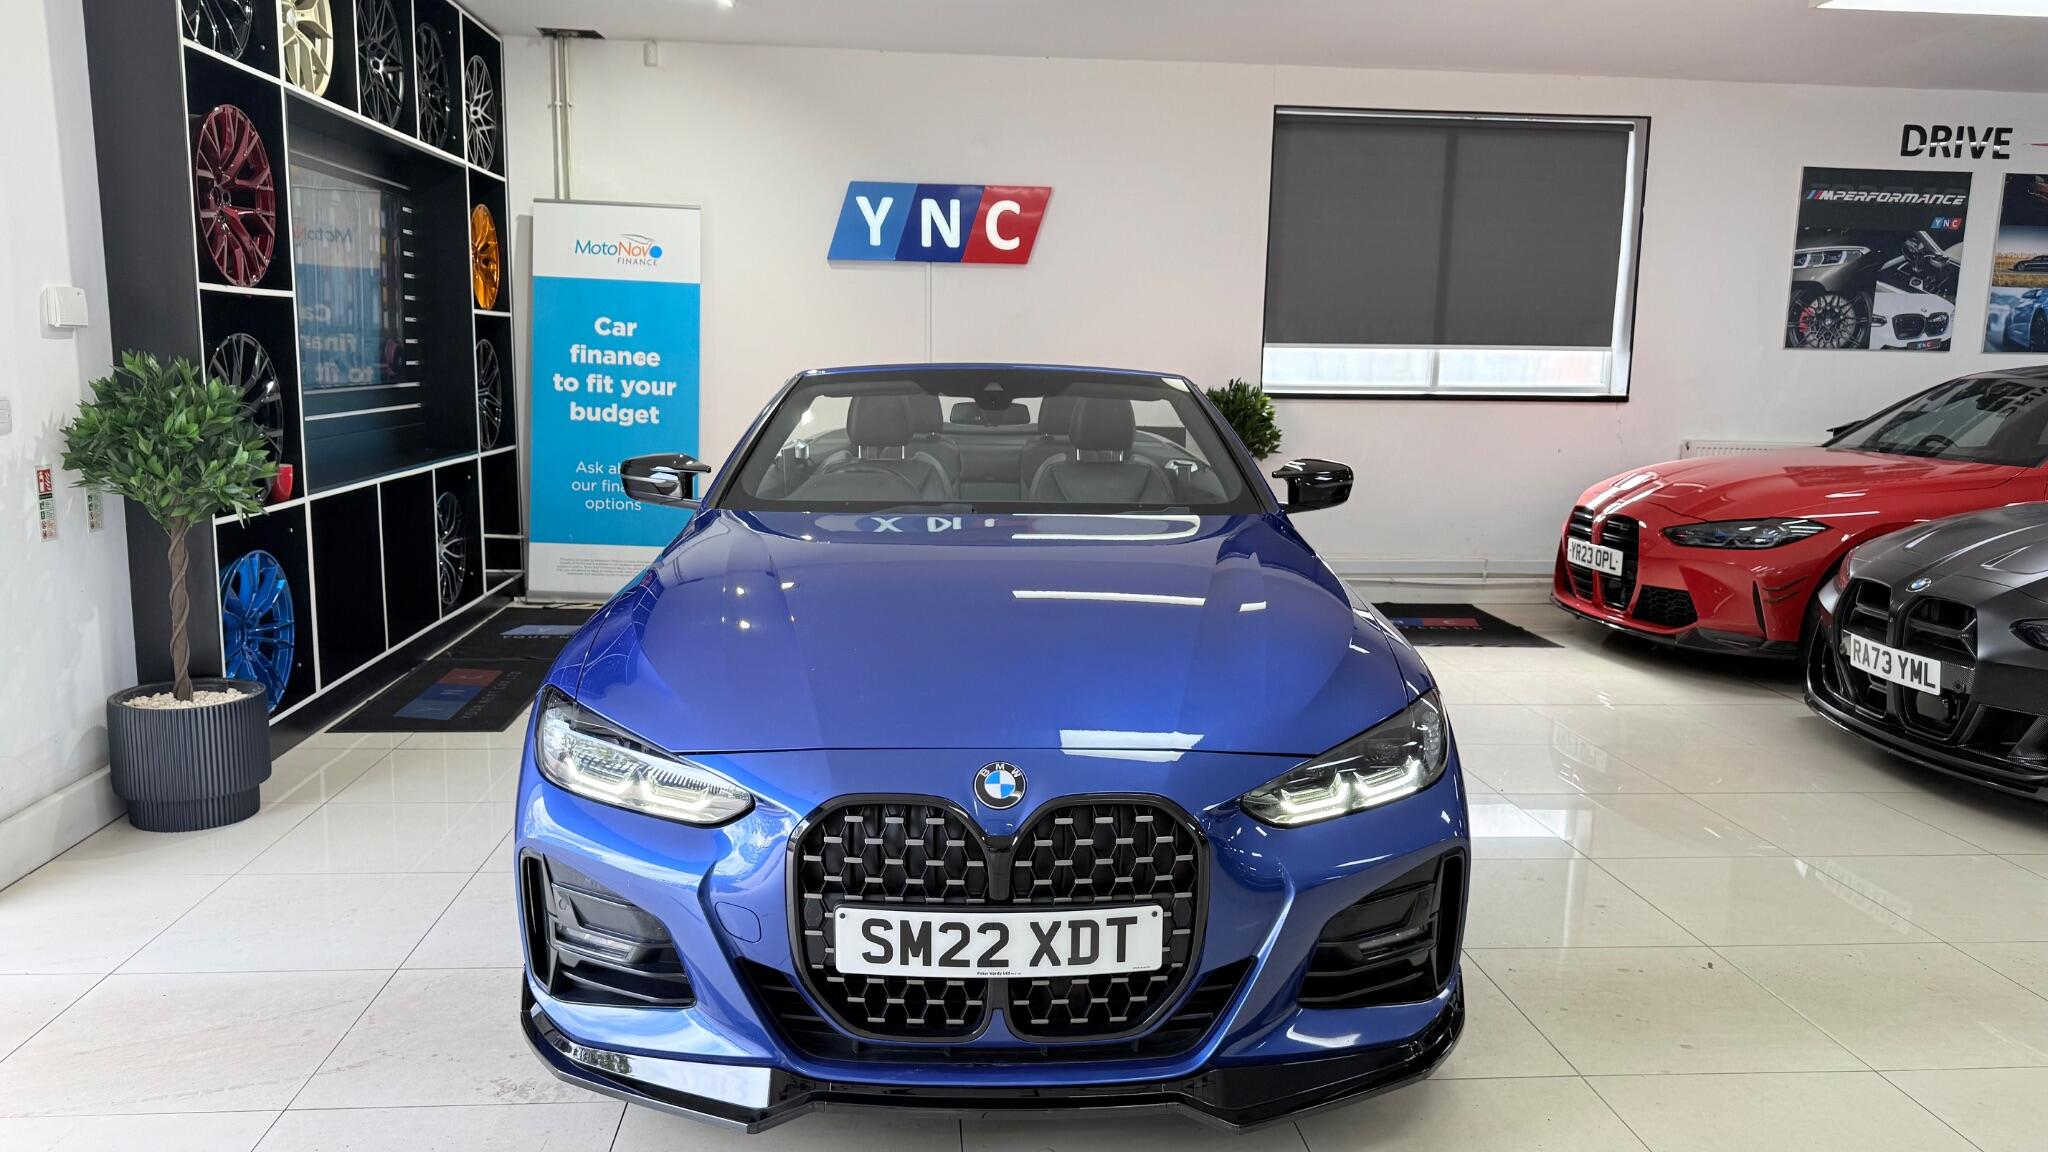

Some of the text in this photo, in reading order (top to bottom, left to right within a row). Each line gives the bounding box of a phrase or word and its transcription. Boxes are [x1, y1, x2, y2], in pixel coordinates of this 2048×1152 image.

[1900, 124, 2013, 160] DRIVE
[855, 195, 1021, 251] YNC
[1935, 218, 1959, 229] YNC
[574, 238, 663, 260] MotoNovo
[616, 256, 658, 267] FINANCE
[594, 316, 638, 337] Car
[569, 343, 662, 367] finance
[552, 373, 678, 398] to fit your
[569, 402, 661, 426] budget
[575, 460, 605, 475] Ask
[571, 481, 597, 492] our
[585, 498, 643, 512] options
[1571, 541, 1617, 571] YR23 OPL
[1853, 638, 1936, 689] RA73 YML
[980, 763, 1022, 778] BMW
[861, 916, 1138, 968] SM22 XDT
